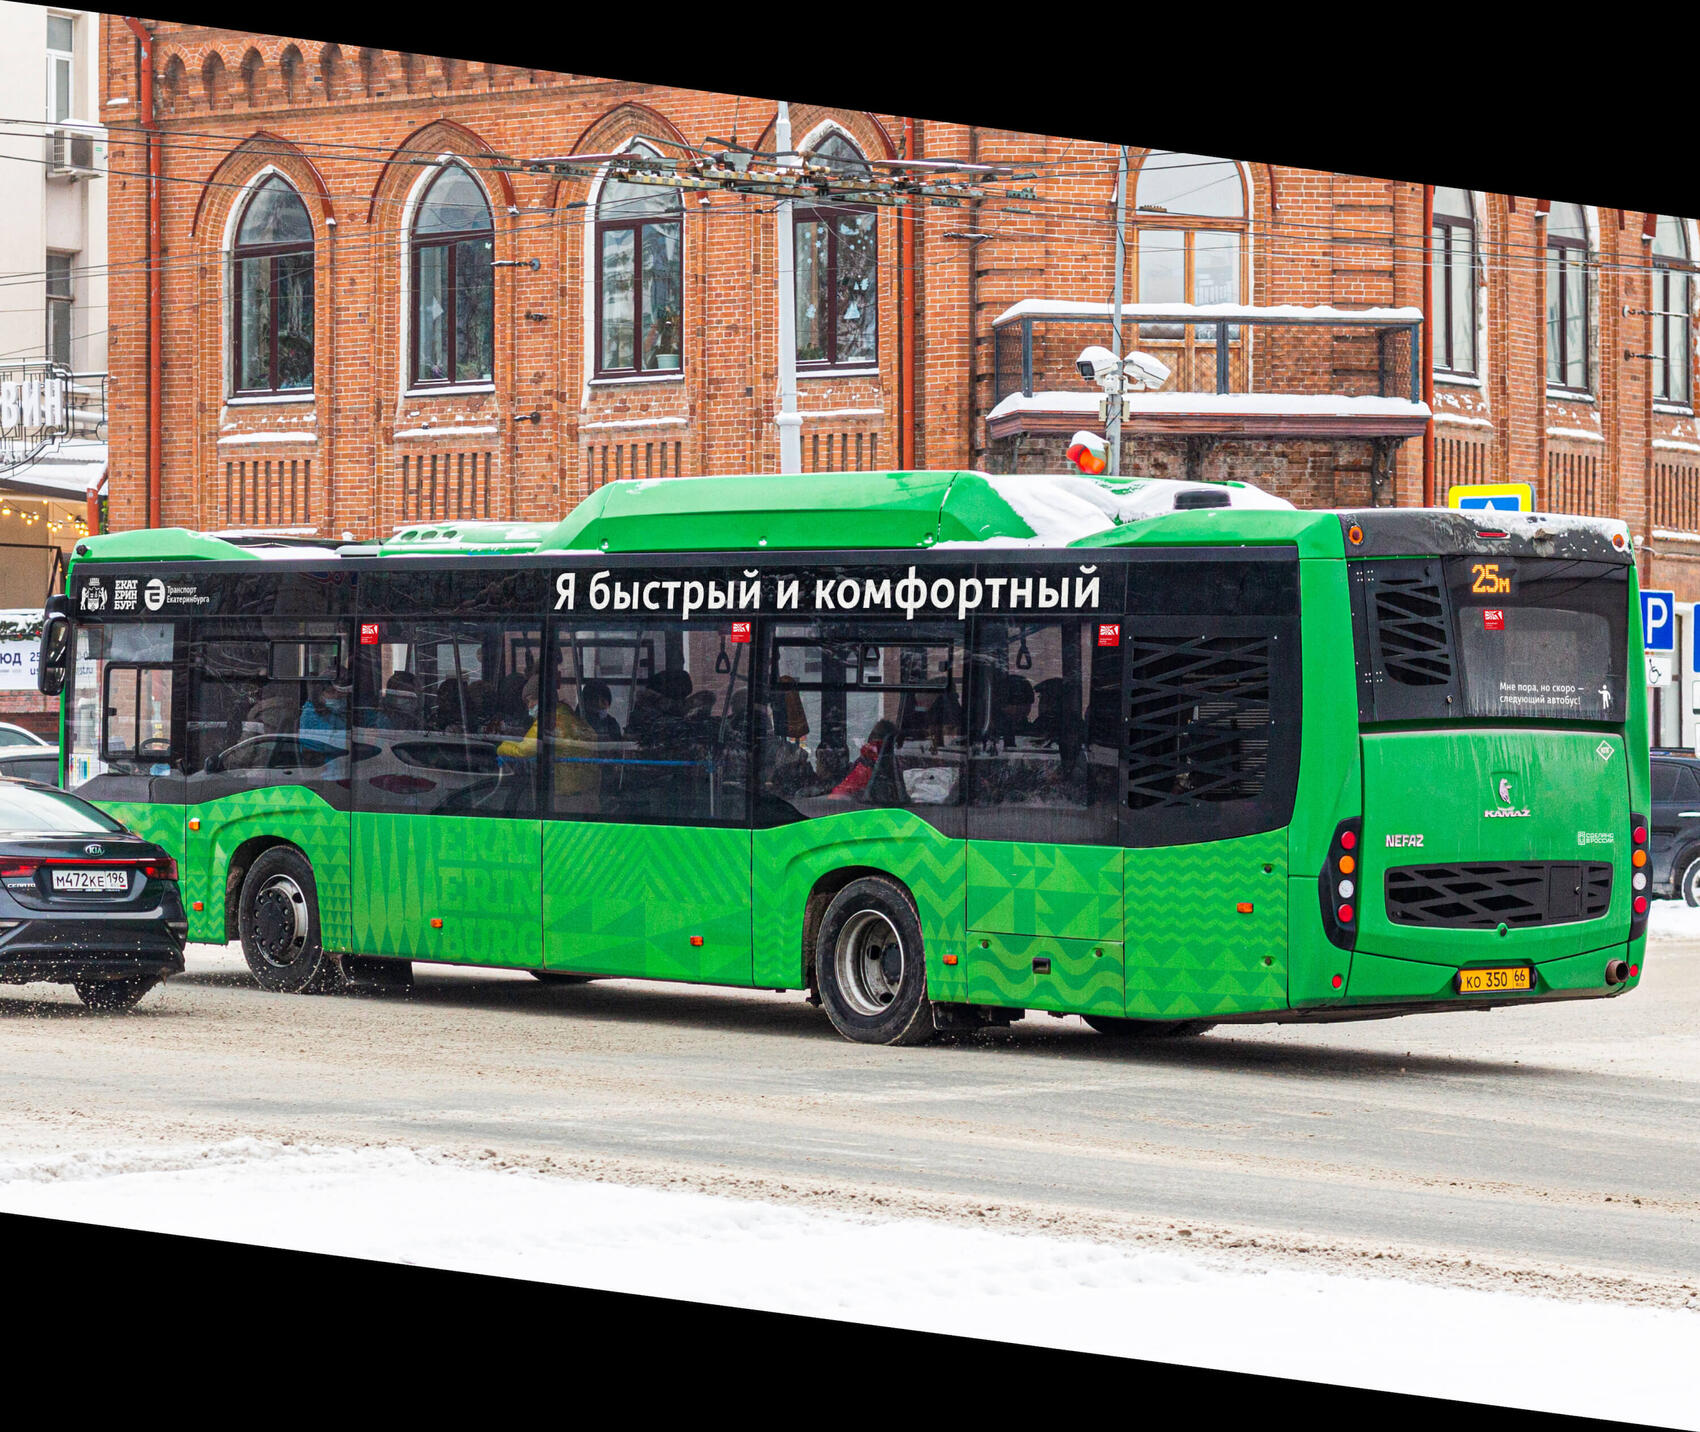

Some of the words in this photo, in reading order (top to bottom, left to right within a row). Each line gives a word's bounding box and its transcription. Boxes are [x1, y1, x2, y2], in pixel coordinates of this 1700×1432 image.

[166, 585, 198, 595] Транспорт
[553, 572, 576, 610] Я
[589, 569, 761, 620] быстрый
[776, 580, 800, 609] и
[814, 564, 1101, 621] комфортный
[166, 594, 210, 605] Екатеринбурга
[1646, 597, 1668, 644] P
[1500, 682, 1516, 692] Мне
[1517, 684, 1539, 693] пора,
[1540, 684, 1551, 692] но
[1552, 685, 1576, 694] скоро
[1499, 695, 1546, 704] следующий
[1546, 697, 1581, 706] автобус!
[1385, 834, 1425, 848] NEFAZ
[1486, 971, 1507, 987] 350
[1514, 969, 1525, 981] 66
